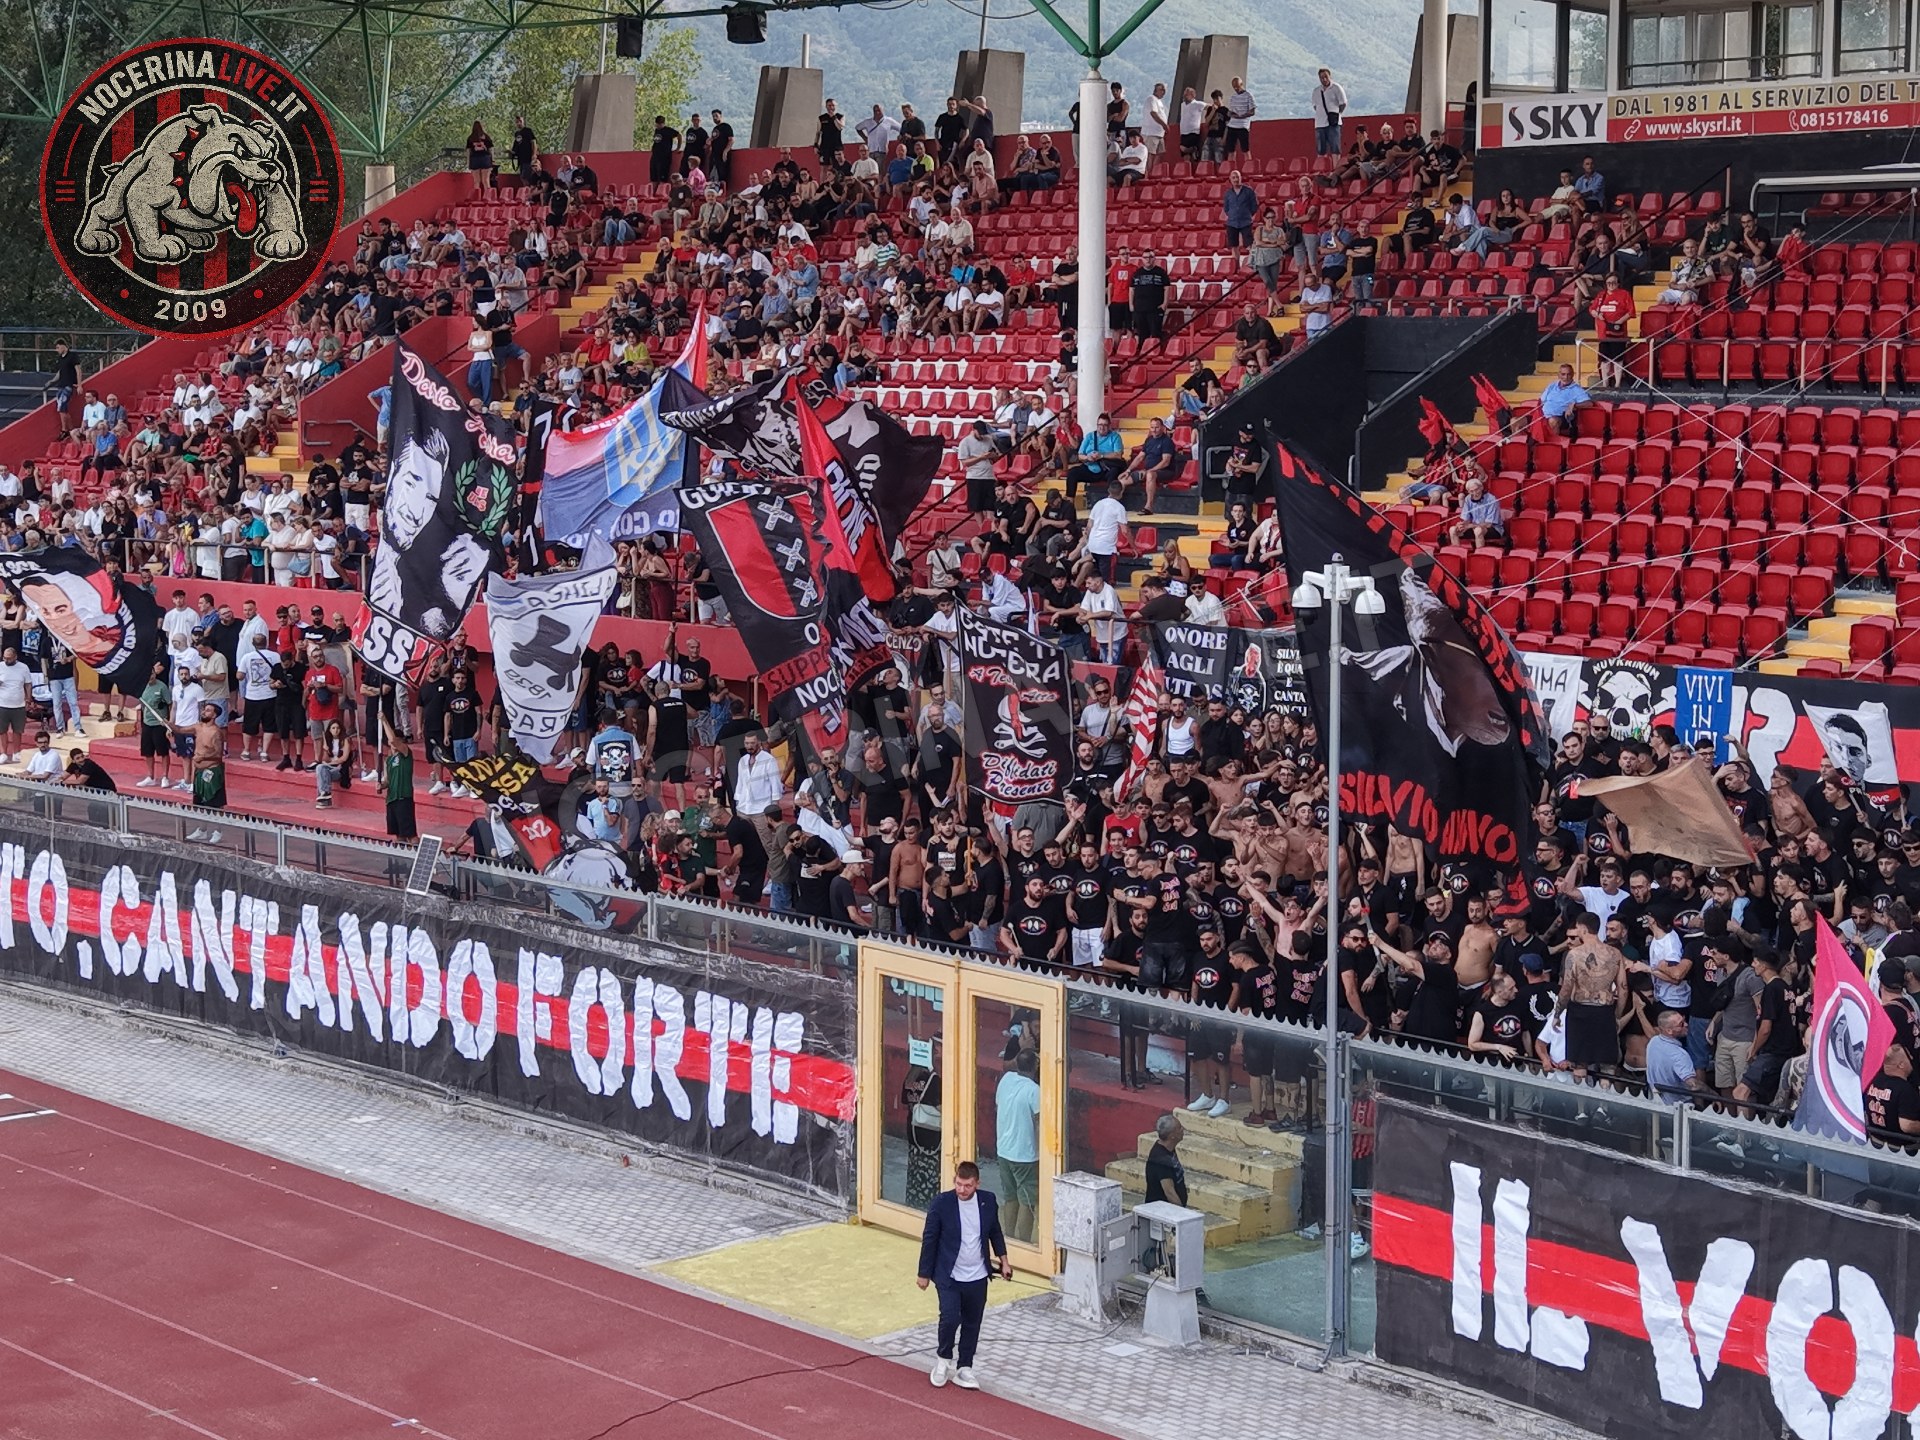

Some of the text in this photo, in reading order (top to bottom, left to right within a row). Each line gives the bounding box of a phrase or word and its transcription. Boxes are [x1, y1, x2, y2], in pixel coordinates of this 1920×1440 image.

[1616, 98, 1653, 117] DAL
[1663, 95, 1709, 113] 1981
[1719, 92, 1743, 110] AL
[1752, 86, 1850, 108] SERVIZIO
[1860, 83, 1899, 102] DEL
[1646, 116, 1742, 137] www.skysrl.it
[1800, 109, 1889, 128] 0815178416
[1164, 626, 1228, 650] ONORE
[1166, 653, 1215, 676] AGLI
[1274, 690, 1307, 703] CANTA
[1684, 673, 1724, 703] VIVI
[1692, 704, 1713, 729] IN
[981, 751, 1057, 781] Diffidati
[988, 769, 1054, 798] Presenti
[1337, 771, 1440, 844] SILVIO
[516, 946, 805, 1145] FORTE
[1450, 1160, 1920, 1440] IL VO
